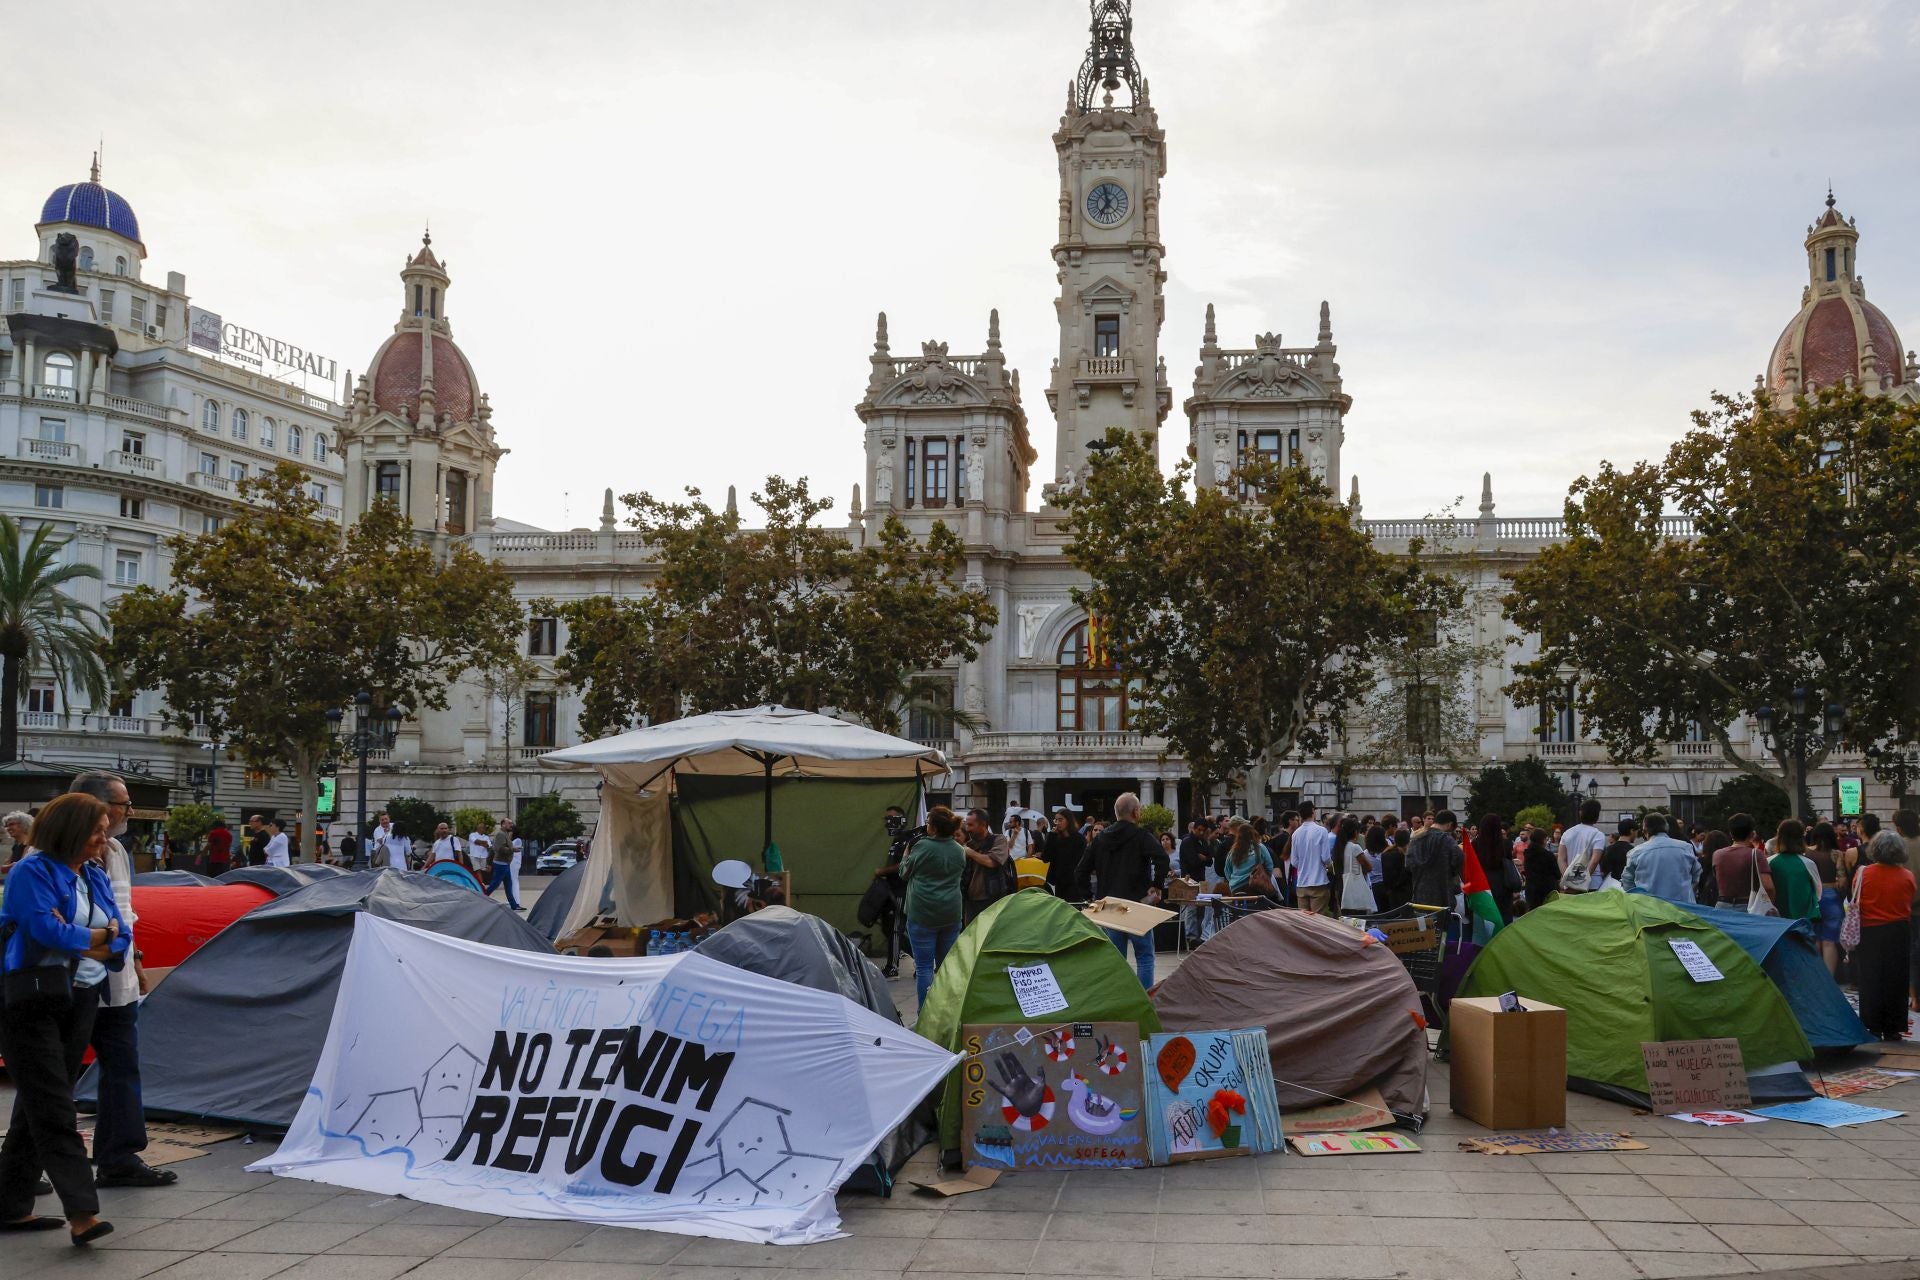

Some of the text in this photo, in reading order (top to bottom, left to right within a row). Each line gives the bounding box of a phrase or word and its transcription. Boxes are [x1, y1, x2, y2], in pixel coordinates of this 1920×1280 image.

[221, 323, 337, 382] GENERALI
[222, 345, 263, 367] Seguros
[1010, 968, 1043, 979] COMPRO
[1013, 979, 1033, 987] PISO
[500, 980, 600, 1031] VALÈNCIA
[1194, 1036, 1232, 1088] OKUPA
[1676, 1057, 1714, 1070] HUELGA
[1701, 1044, 1712, 1055] LA
[478, 1025, 736, 1112] NO TENIM
[966, 1034, 986, 1106] SOS
[1690, 1073, 1702, 1081] DE
[444, 1095, 703, 1195] REFUGI
